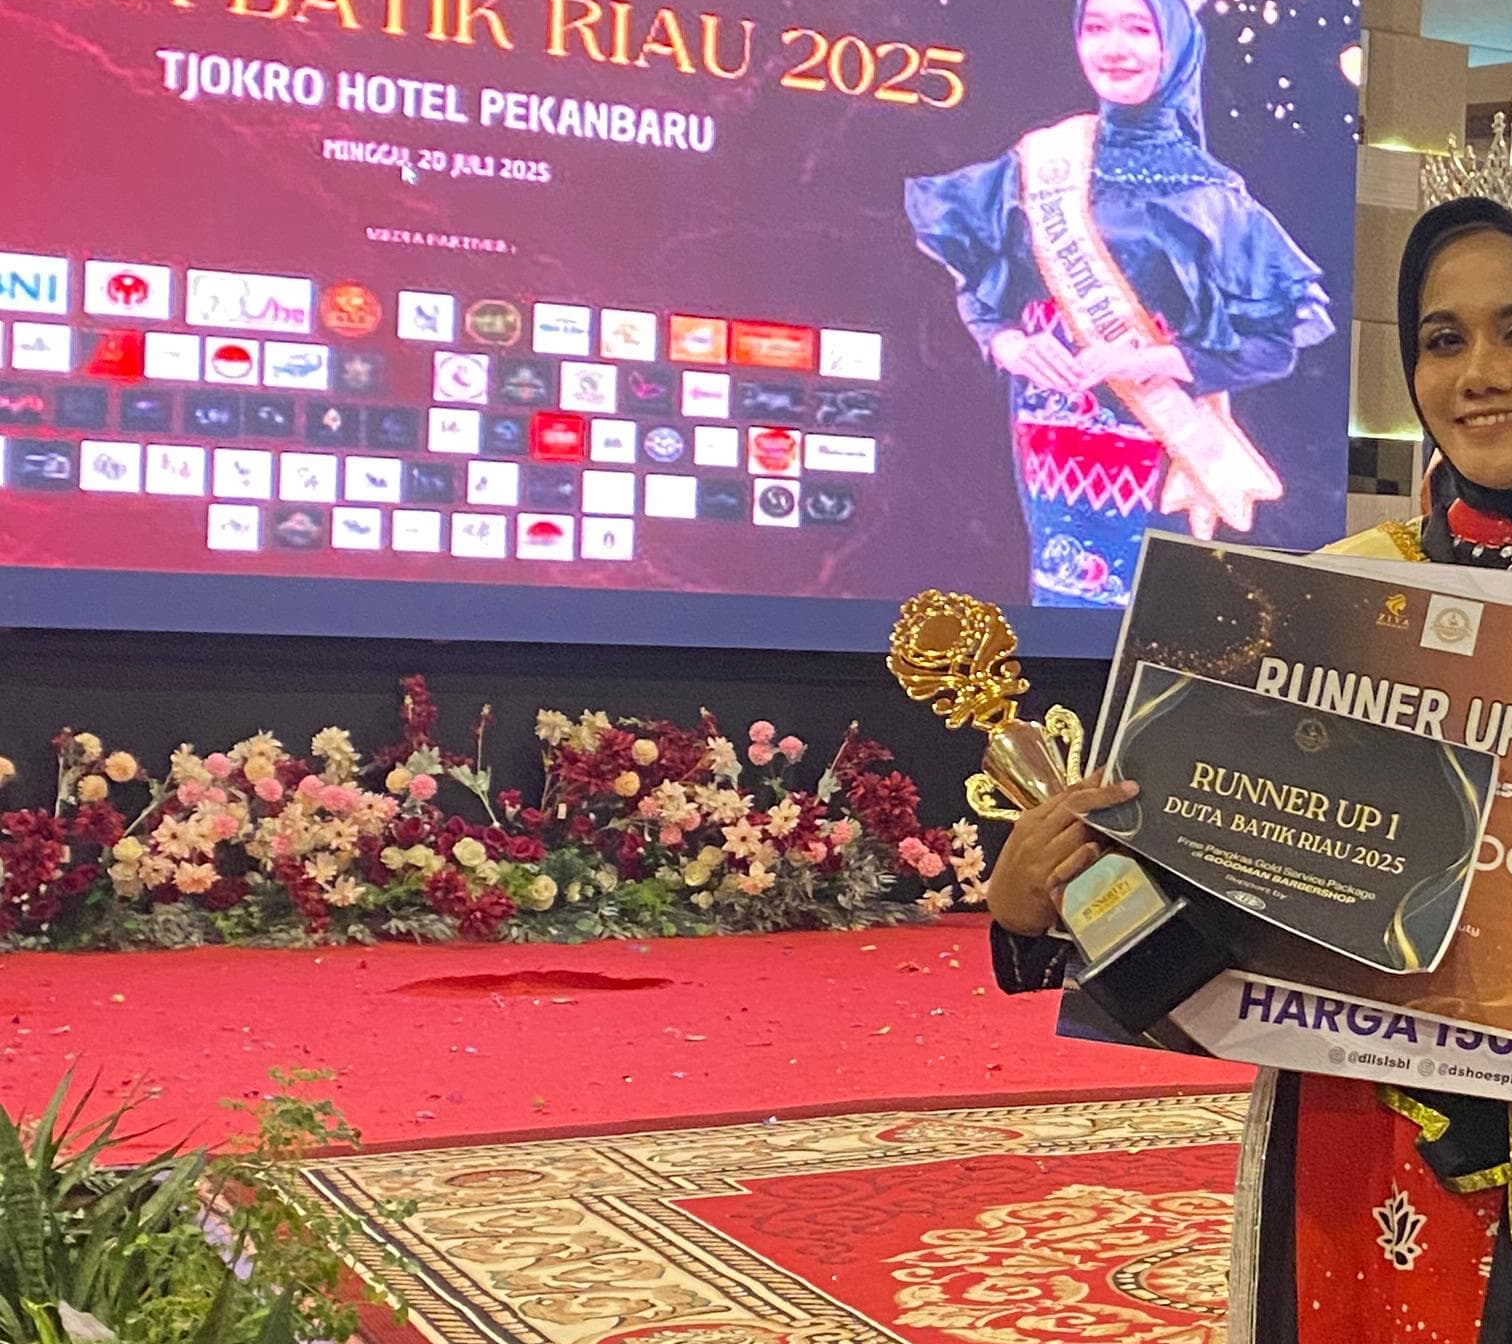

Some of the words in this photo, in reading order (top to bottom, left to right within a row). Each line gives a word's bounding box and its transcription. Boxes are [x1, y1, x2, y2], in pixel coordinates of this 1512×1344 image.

[155, 49, 325, 106] TJOKRO
[338, 71, 468, 123] HOTEL
[481, 88, 716, 154] PEKANBARU
[779, 27, 965, 109] 2025
[417, 149, 447, 172] 20
[500, 158, 551, 183] 2025
[0, 271, 57, 303] NI
[1256, 656, 1450, 741] RUNNER
[1163, 796, 1223, 827] DUTA
[1230, 813, 1297, 846] BATIK
[1297, 831, 1352, 860] RIAU
[1352, 846, 1407, 875] 2025
[1190, 762, 1329, 823] RUNNER
[1336, 800, 1382, 833] UP
[1386, 813, 1400, 840] 1
[1204, 854, 1272, 879] GOODMAN
[1271, 875, 1356, 904] BARBERSHOP
[1255, 859, 1282, 874] Gold
[1283, 867, 1326, 886] Service
[1326, 879, 1376, 900] Package
[1239, 982, 1418, 1043] HARGA
